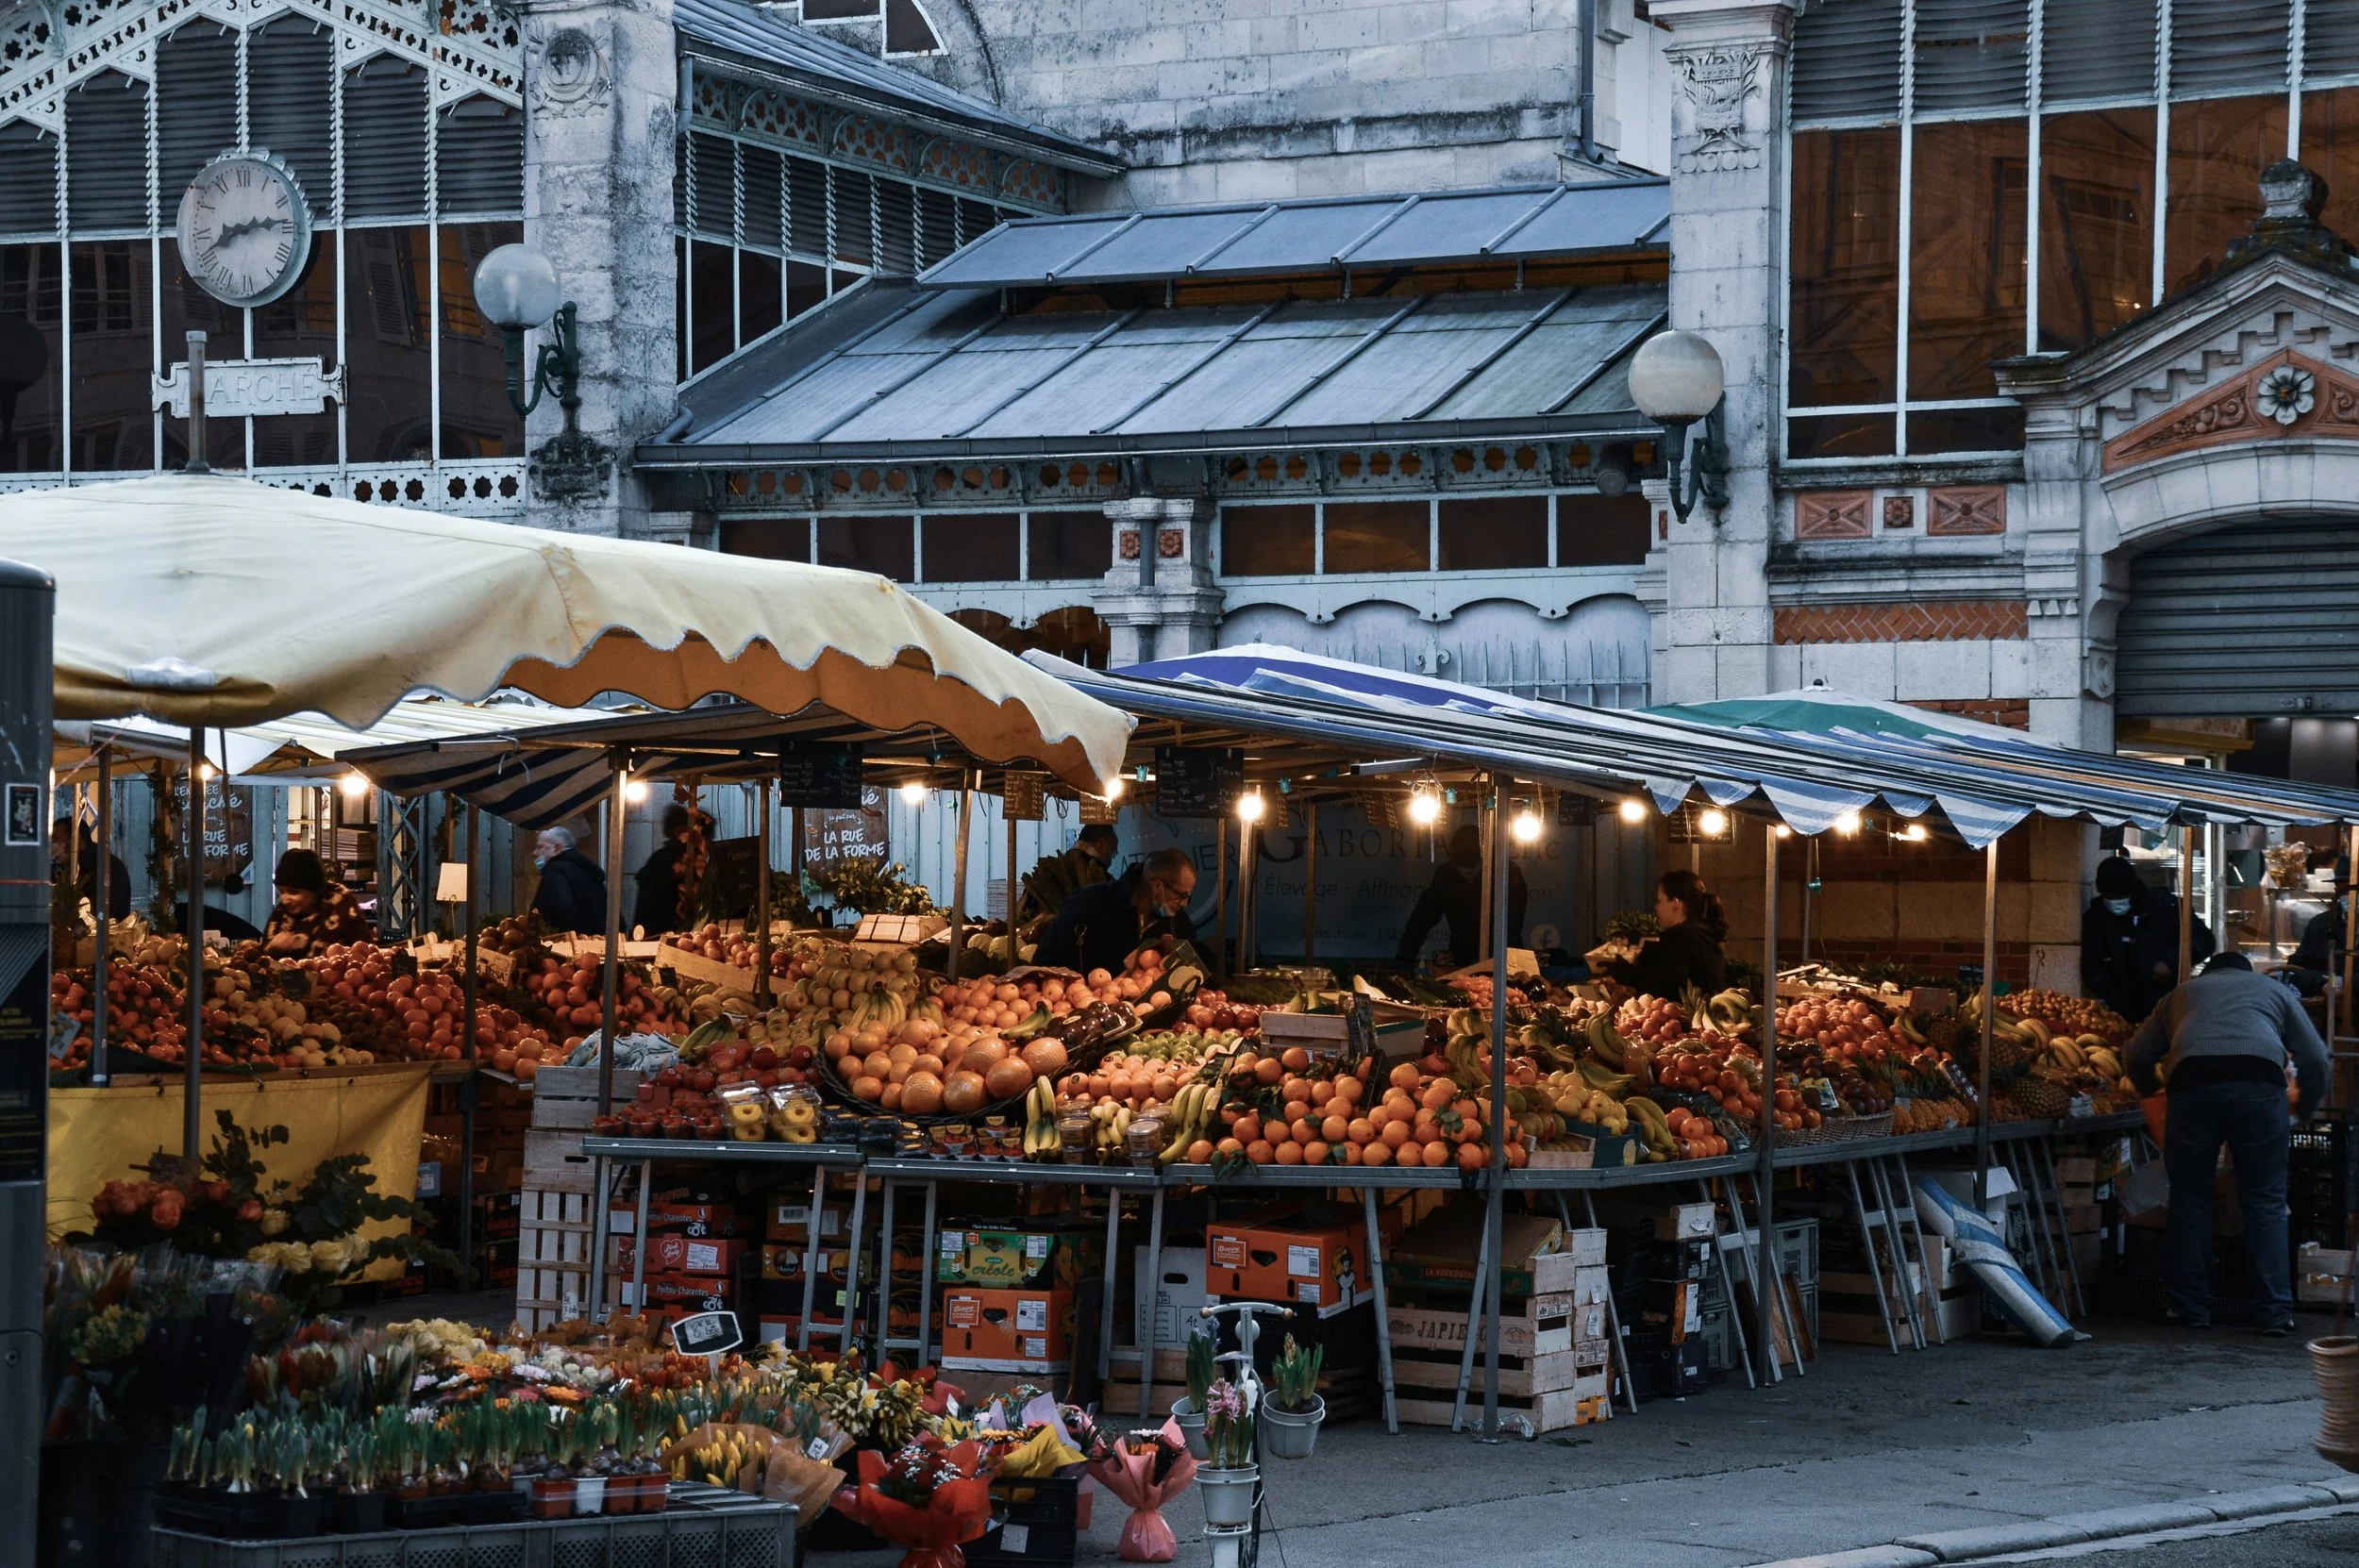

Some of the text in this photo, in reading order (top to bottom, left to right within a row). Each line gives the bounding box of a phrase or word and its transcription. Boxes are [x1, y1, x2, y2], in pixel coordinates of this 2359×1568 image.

[178, 364, 320, 406] ARCHÉ
[824, 828, 864, 844] LA RUE
[805, 842, 885, 862] DE LA FORME
[973, 1262, 1016, 1276] créole
[656, 1283, 709, 1297] Poitou-Charentes
